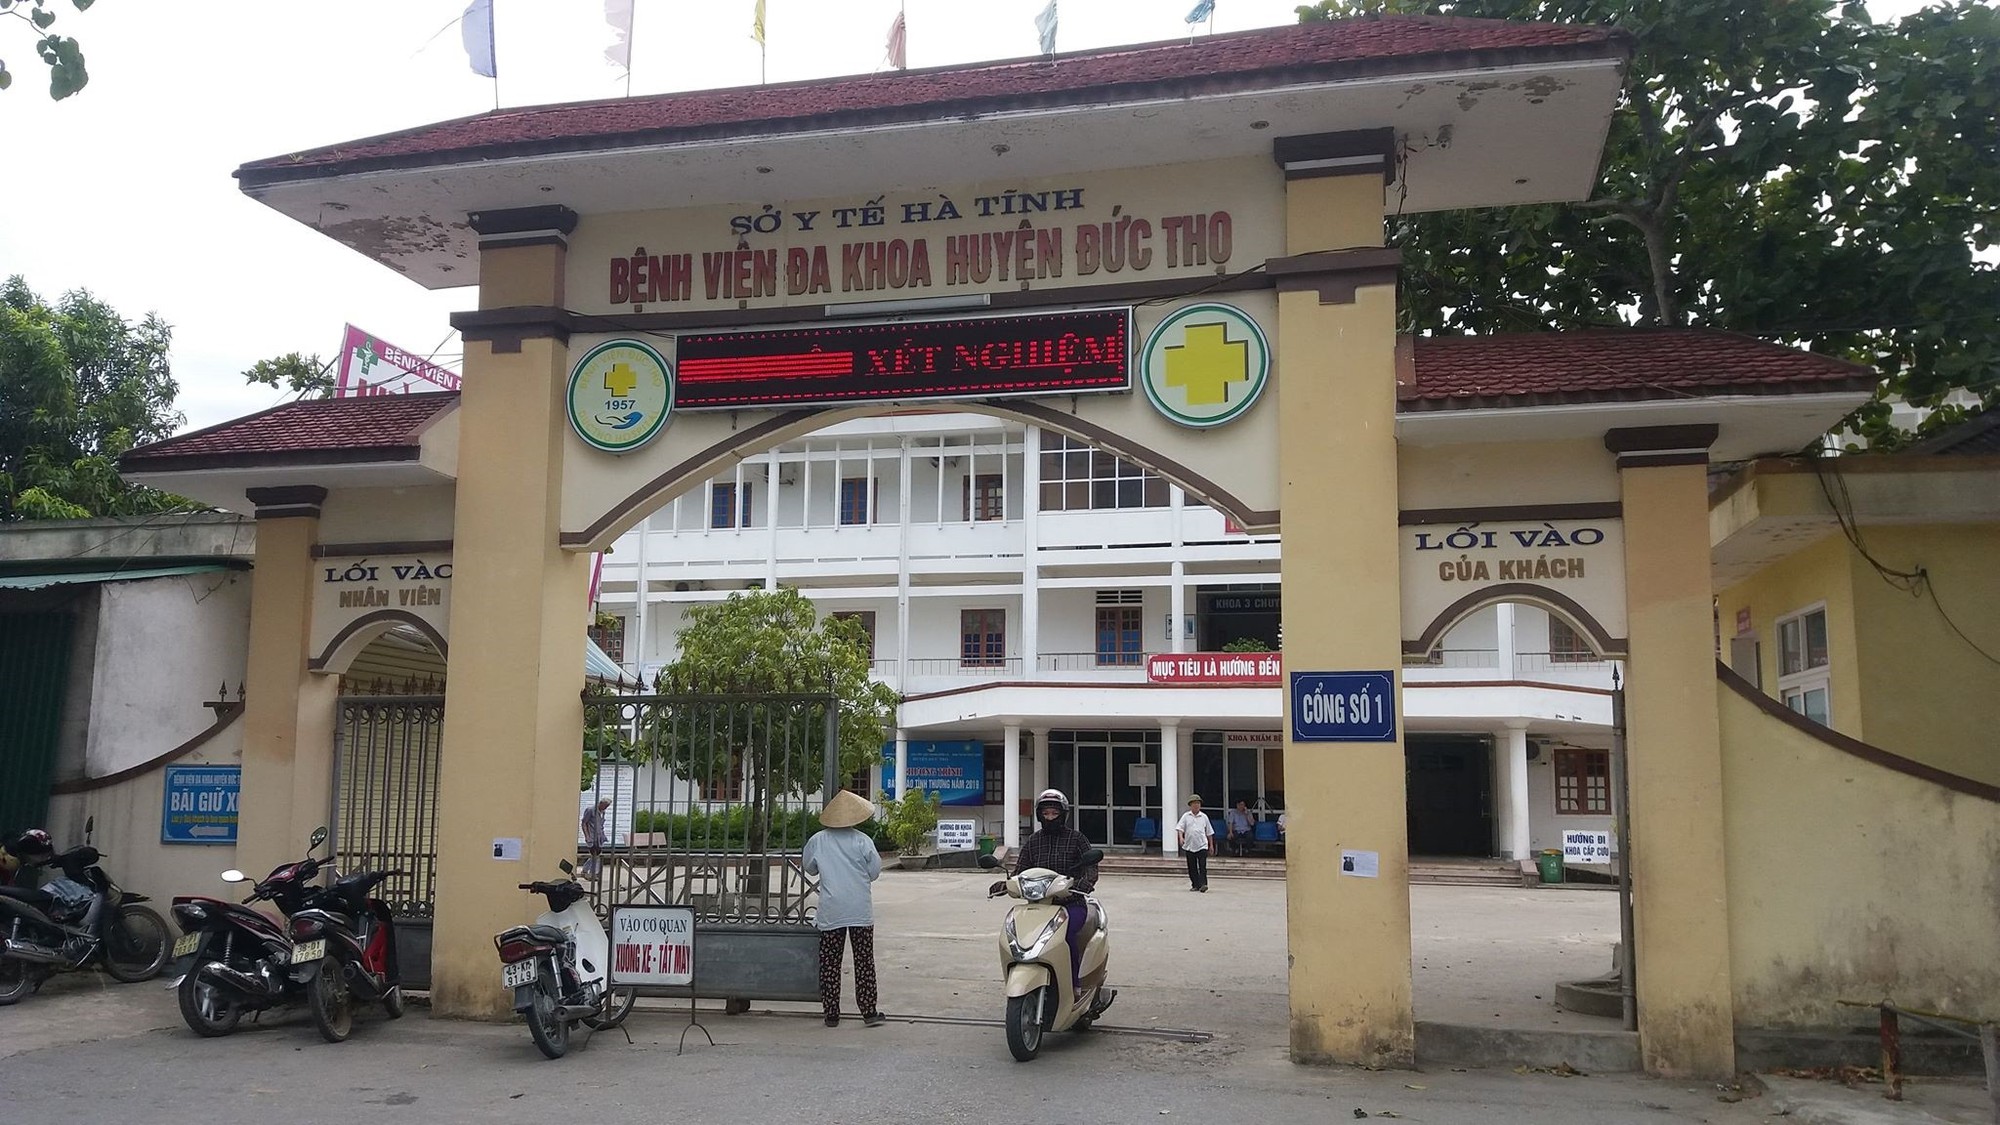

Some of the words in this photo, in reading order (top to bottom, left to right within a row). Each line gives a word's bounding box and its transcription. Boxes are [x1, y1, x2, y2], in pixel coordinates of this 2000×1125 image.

[730, 204, 782, 235] SỞ
[793, 210, 820, 231] Y
[832, 195, 885, 228] TẾ
[900, 194, 962, 224] HÀ
[974, 188, 1085, 218] TĨNH
[610, 247, 692, 312] BỆNH
[702, 240, 777, 309] VIỆN
[787, 245, 831, 296] ĐA
[842, 238, 932, 292] KHOA
[946, 219, 1062, 291] HUYỆN
[1075, 205, 1152, 276] ĐỨC
[1161, 210, 1232, 274] THỌ
[383, 346, 421, 374] BỆNH
[424, 368, 453, 389] VIỆN
[605, 400, 636, 411] 1957
[1415, 522, 1498, 550] LỐI
[1510, 523, 1605, 548] VÀO
[324, 558, 379, 582] LỐI
[391, 559, 453, 581] VÀO
[1439, 554, 1490, 581] CỦA
[1499, 555, 1585, 581] KHÁCH
[339, 586, 389, 608] NHÂN
[398, 585, 441, 606] VIÊN
[1216, 599, 1241, 608] KHOA
[1244, 598, 1251, 608] 3
[1254, 598, 1280, 608] CHUY
[1152, 661, 1175, 679] MỤC
[1178, 658, 1200, 676] TIÊU
[1204, 657, 1217, 676] LÀ
[1220, 656, 1254, 676] HƯỚNG
[1259, 655, 1280, 676] ĐẾN
[1303, 682, 1345, 724] CỔNG
[1349, 683, 1370, 724] SỐ
[1375, 694, 1383, 723] 1
[1250, 733, 1271, 742] KHÁM
[1274, 733, 1284, 742] BỆ
[171, 788, 194, 811] BÃI
[198, 787, 225, 811] GIỮ
[1567, 833, 1594, 844] HƯỚNG
[1597, 835, 1606, 844] ĐI
[1565, 847, 1581, 856] KHOA
[620, 915, 641, 933] VÀO
[643, 917, 658, 933] CƠ
[659, 918, 687, 936] QUAN
[615, 935, 641, 974] XUỐNG
[674, 939, 691, 974] MÁY
[508, 970, 532, 986] 9149
